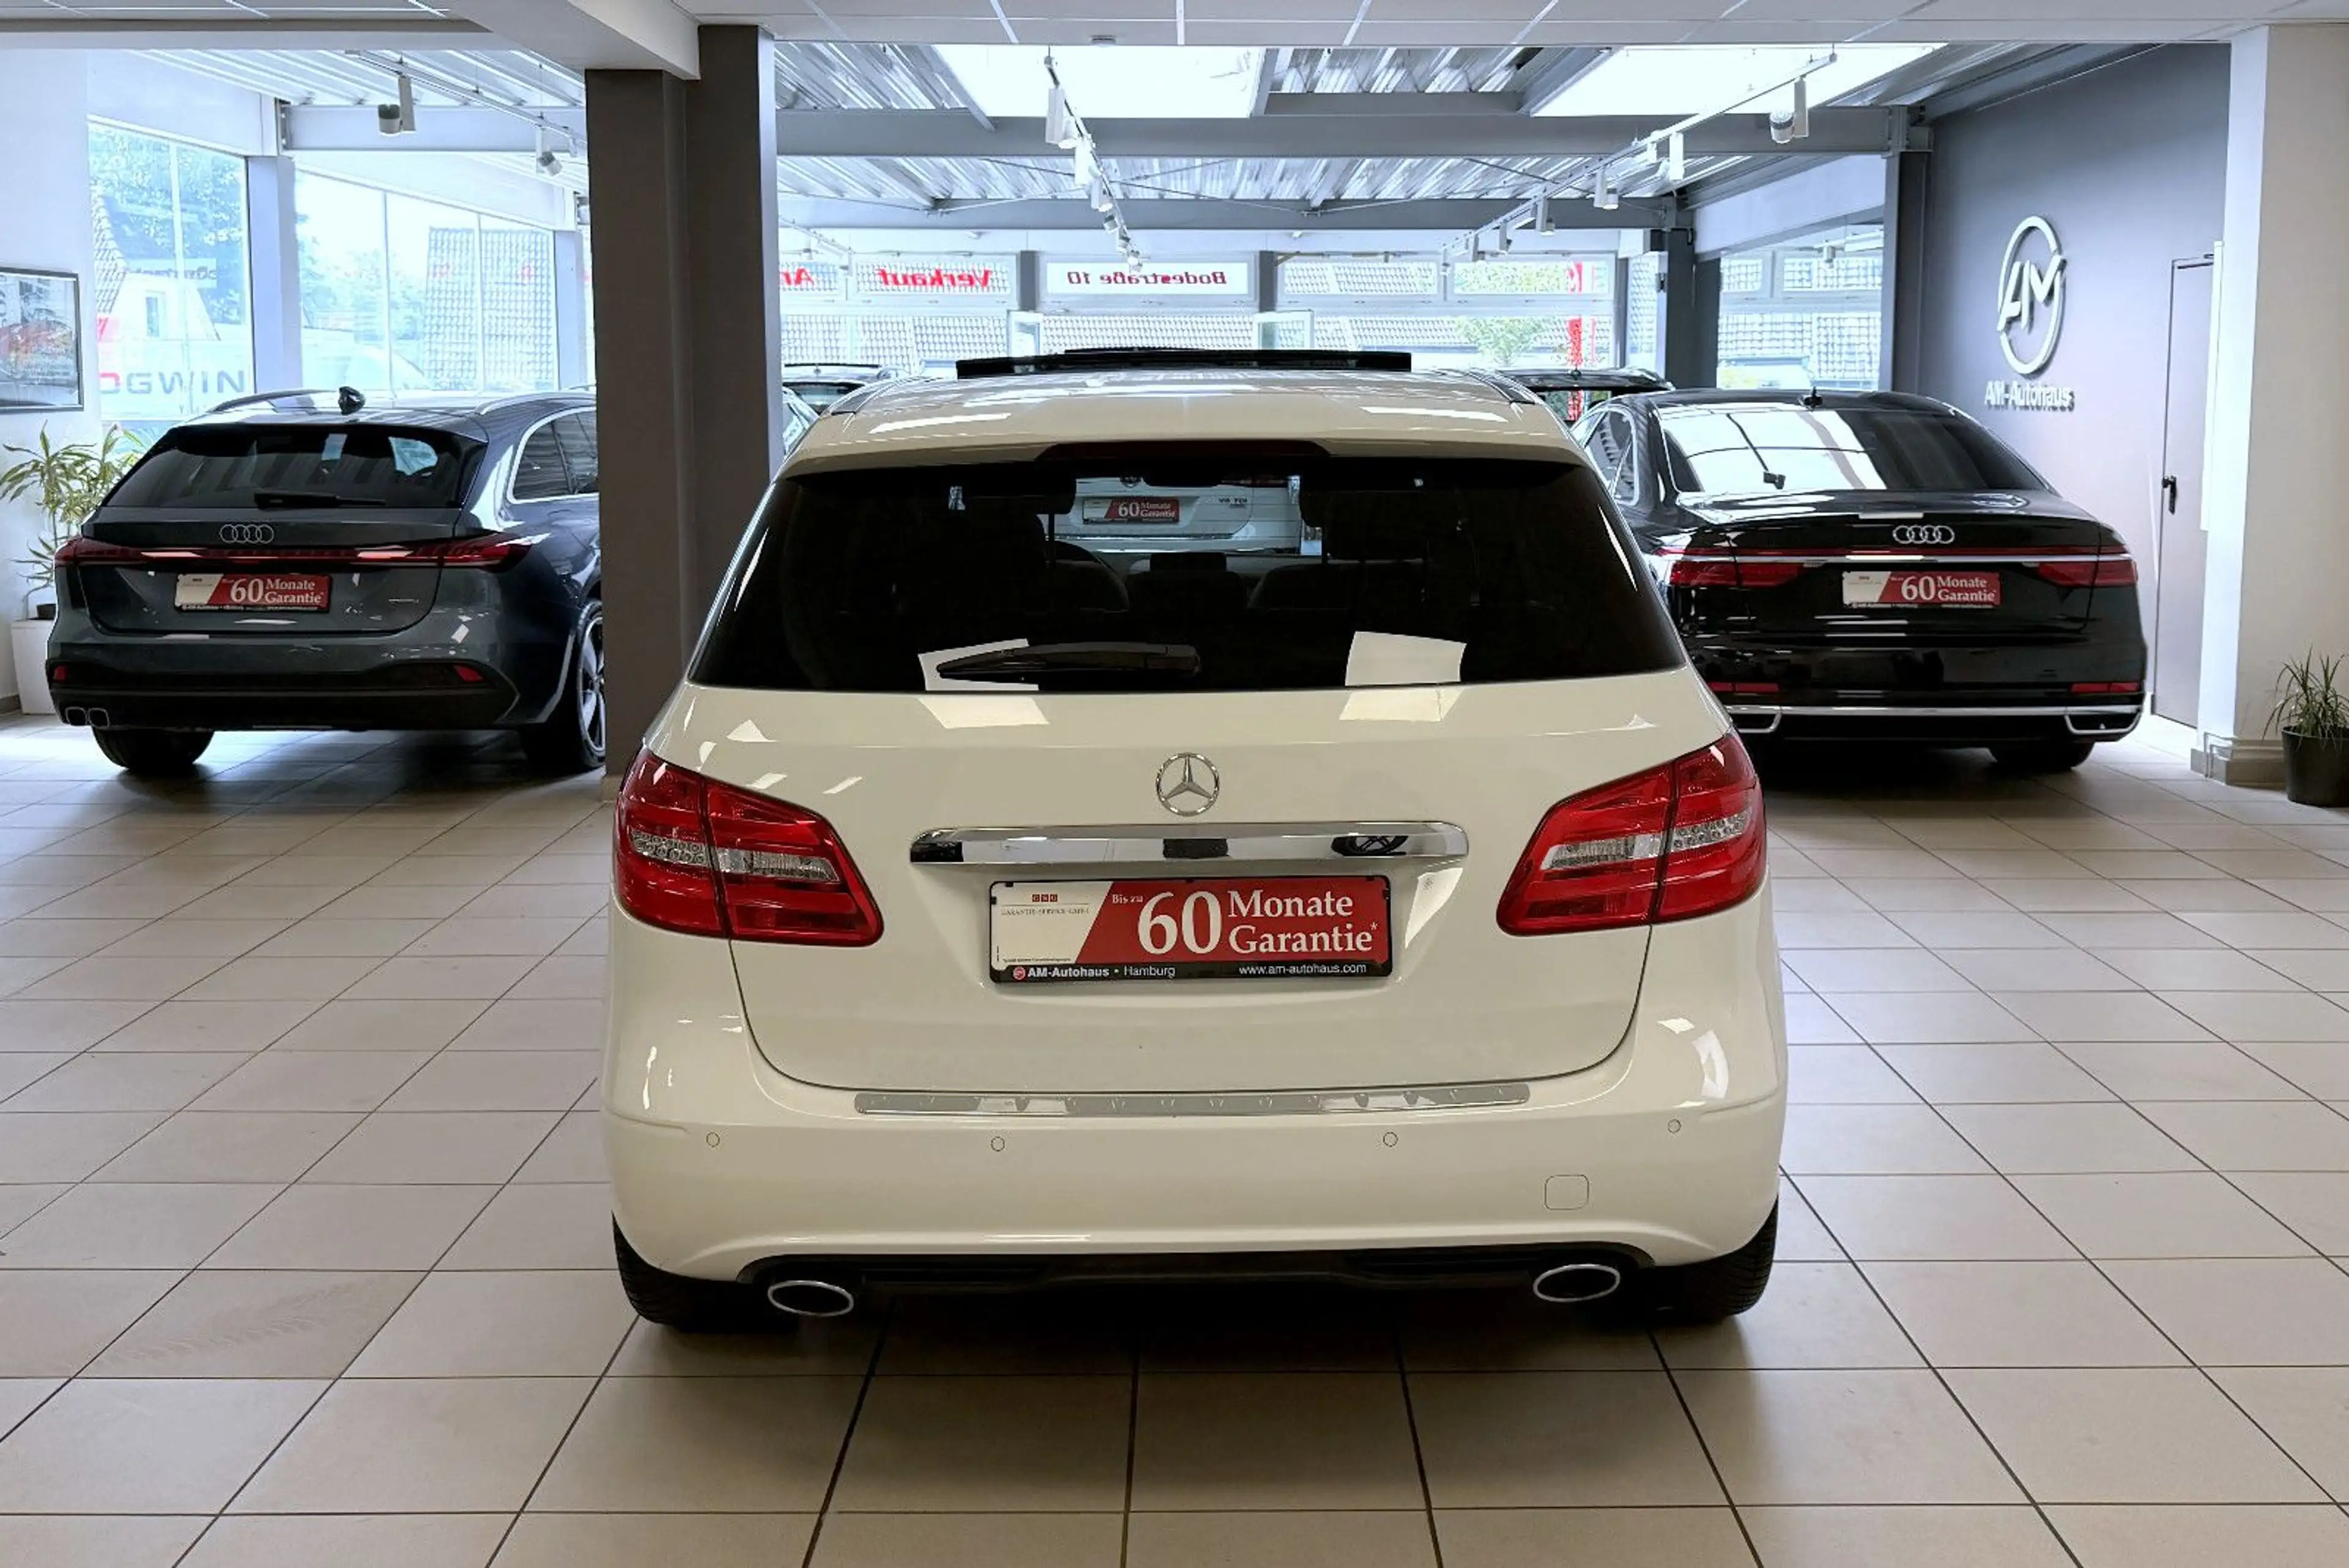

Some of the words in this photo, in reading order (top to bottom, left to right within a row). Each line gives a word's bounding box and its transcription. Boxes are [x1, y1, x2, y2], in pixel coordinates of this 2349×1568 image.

[1984, 380, 2074, 411] AM-Autohaus
[1118, 502, 1140, 518] 60
[230, 578, 264, 603] 60
[265, 578, 316, 590] Monate
[1901, 576, 1936, 601] 60
[1937, 576, 1987, 588] Monate
[1111, 894, 1129, 904] Bis
[1130, 894, 1144, 904] zu
[1138, 891, 1222, 955] 60
[1227, 889, 1354, 917] Monate
[1027, 966, 1110, 978] AM-Autohaus
[1124, 965, 1176, 978] Hamburg
[1239, 963, 1367, 975] www.am-autohaus.com
